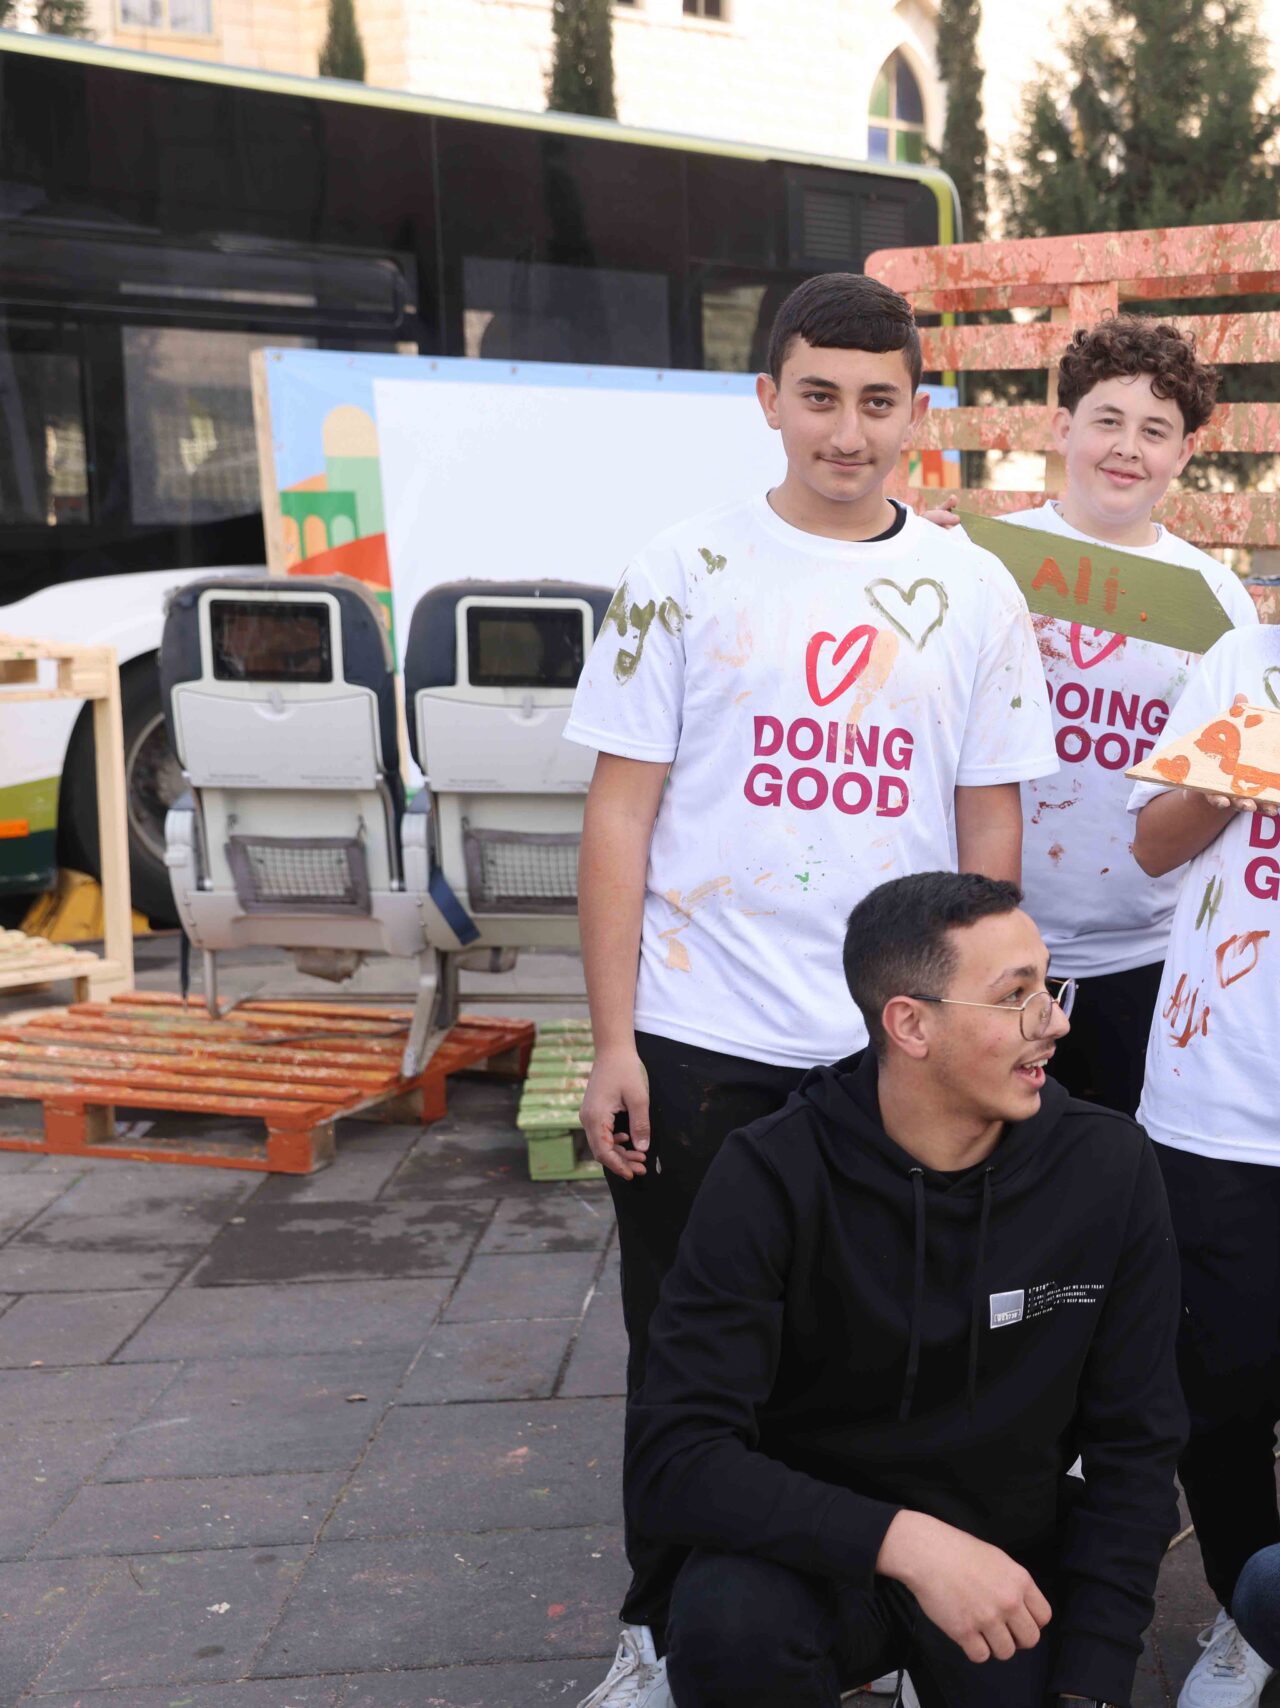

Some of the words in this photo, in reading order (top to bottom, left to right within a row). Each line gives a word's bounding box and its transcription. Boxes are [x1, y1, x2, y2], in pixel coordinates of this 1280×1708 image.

[1031, 556, 1120, 616] Ali
[1045, 680, 1170, 736] OING
[753, 715, 914, 771] DOING
[743, 763, 910, 817] GOOD
